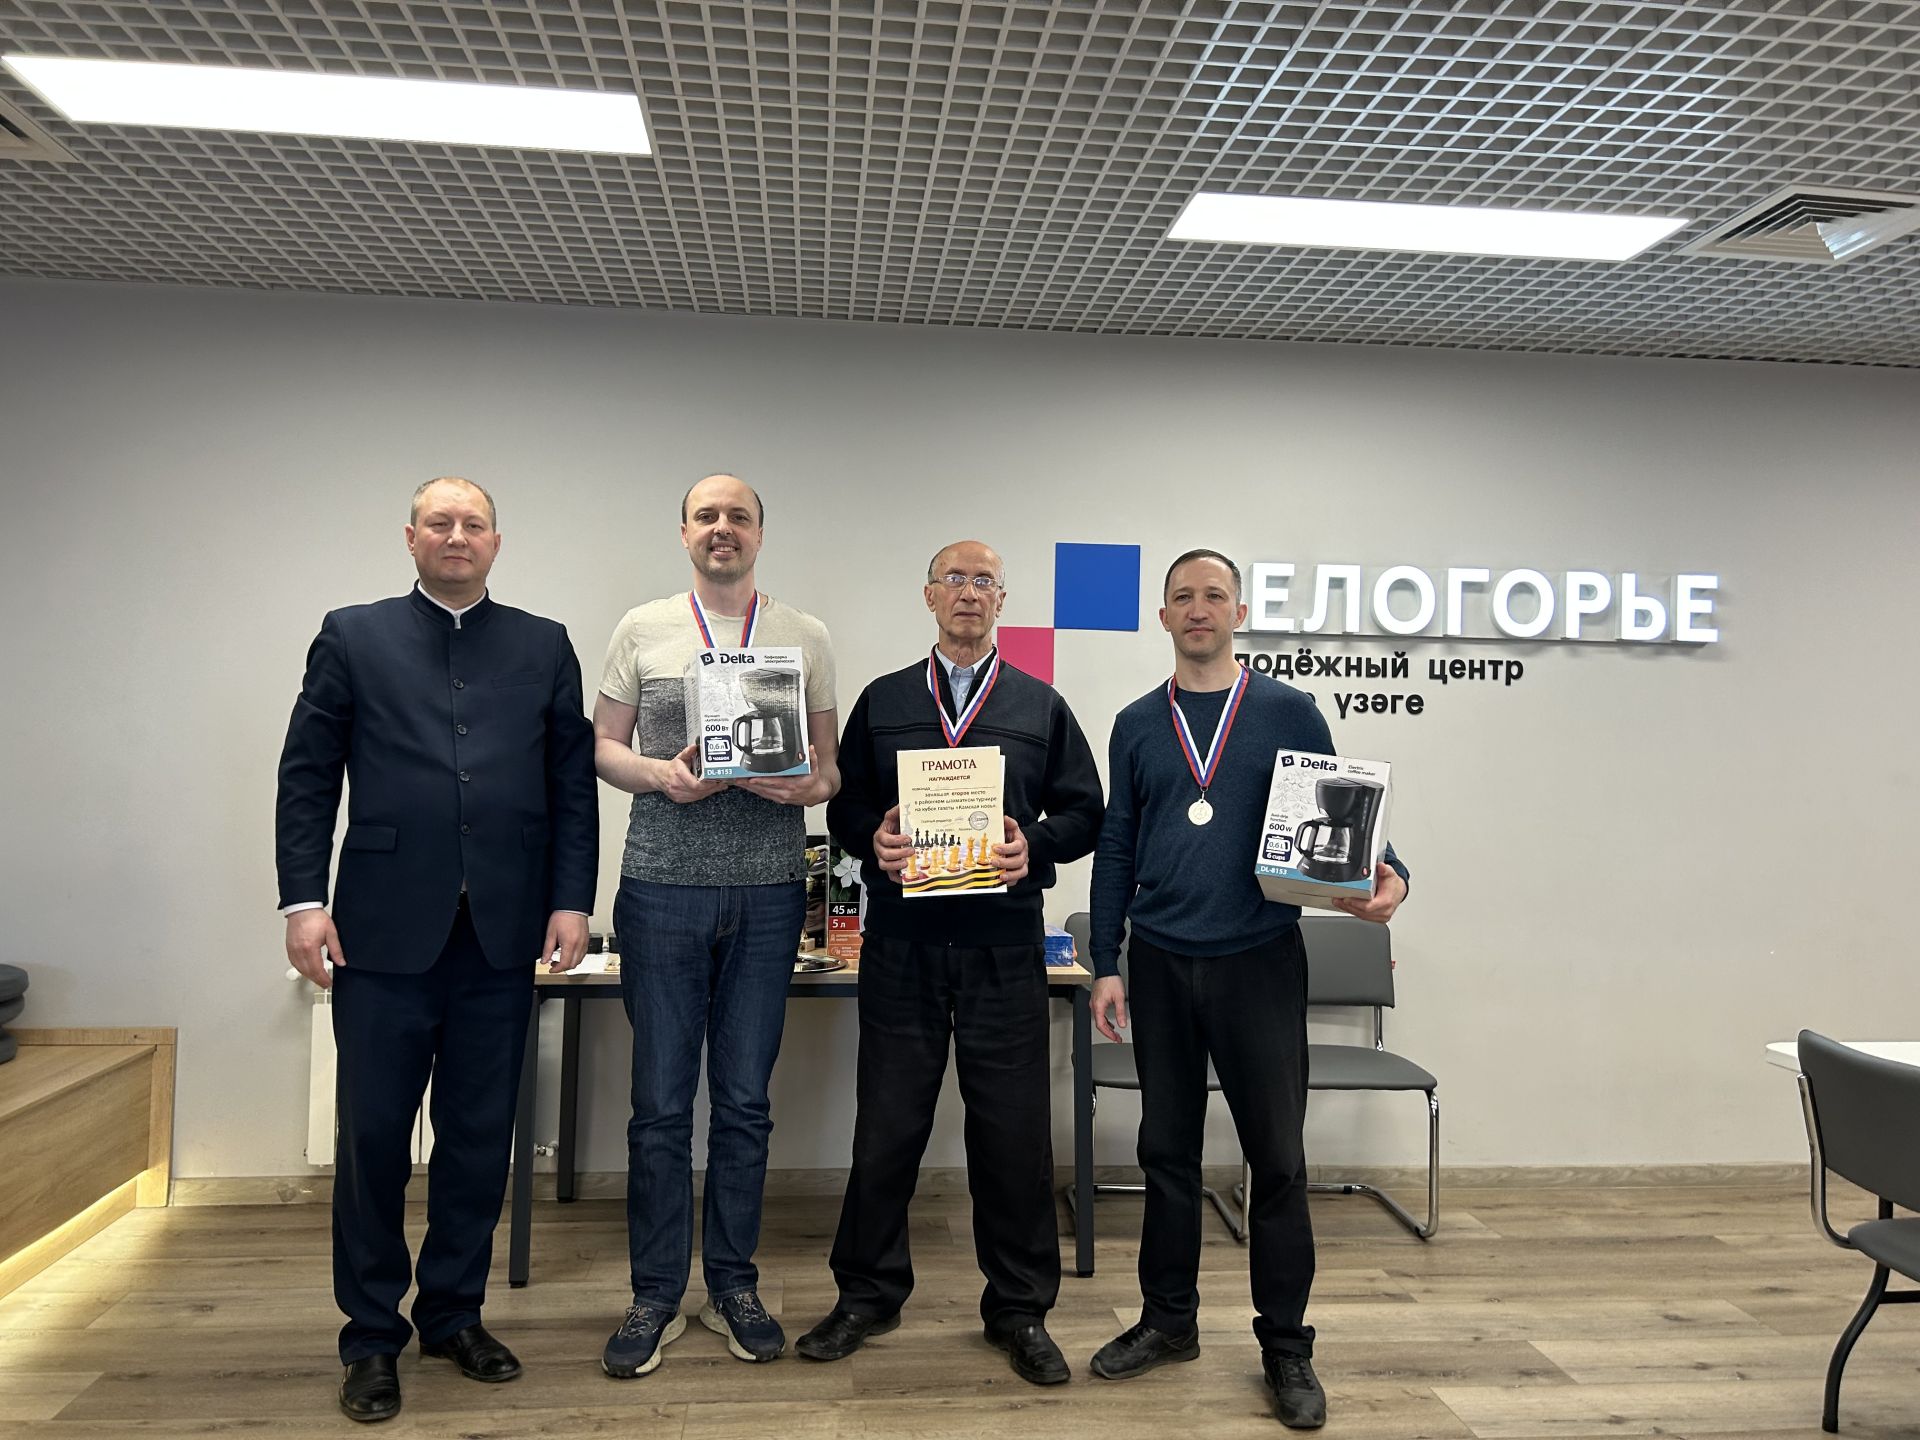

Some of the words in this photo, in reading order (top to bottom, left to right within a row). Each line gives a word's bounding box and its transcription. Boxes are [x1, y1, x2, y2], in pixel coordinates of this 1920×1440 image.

[1249, 562, 1719, 643] ЕЛОГОРЬЕ
[719, 653, 755, 664] Delta
[1234, 648, 1409, 680] лодёжный
[1428, 658, 1524, 686] центр
[1334, 692, 1425, 720] үзәге
[705, 724, 721, 732] 600
[922, 758, 977, 771] ГРАМОТА
[1300, 757, 1338, 772] Delta
[707, 768, 733, 776] DL-8153
[1269, 823, 1285, 831] 600
[1260, 865, 1288, 875] DL-8153
[832, 905, 845, 915] 45
[832, 919, 839, 928] 5
